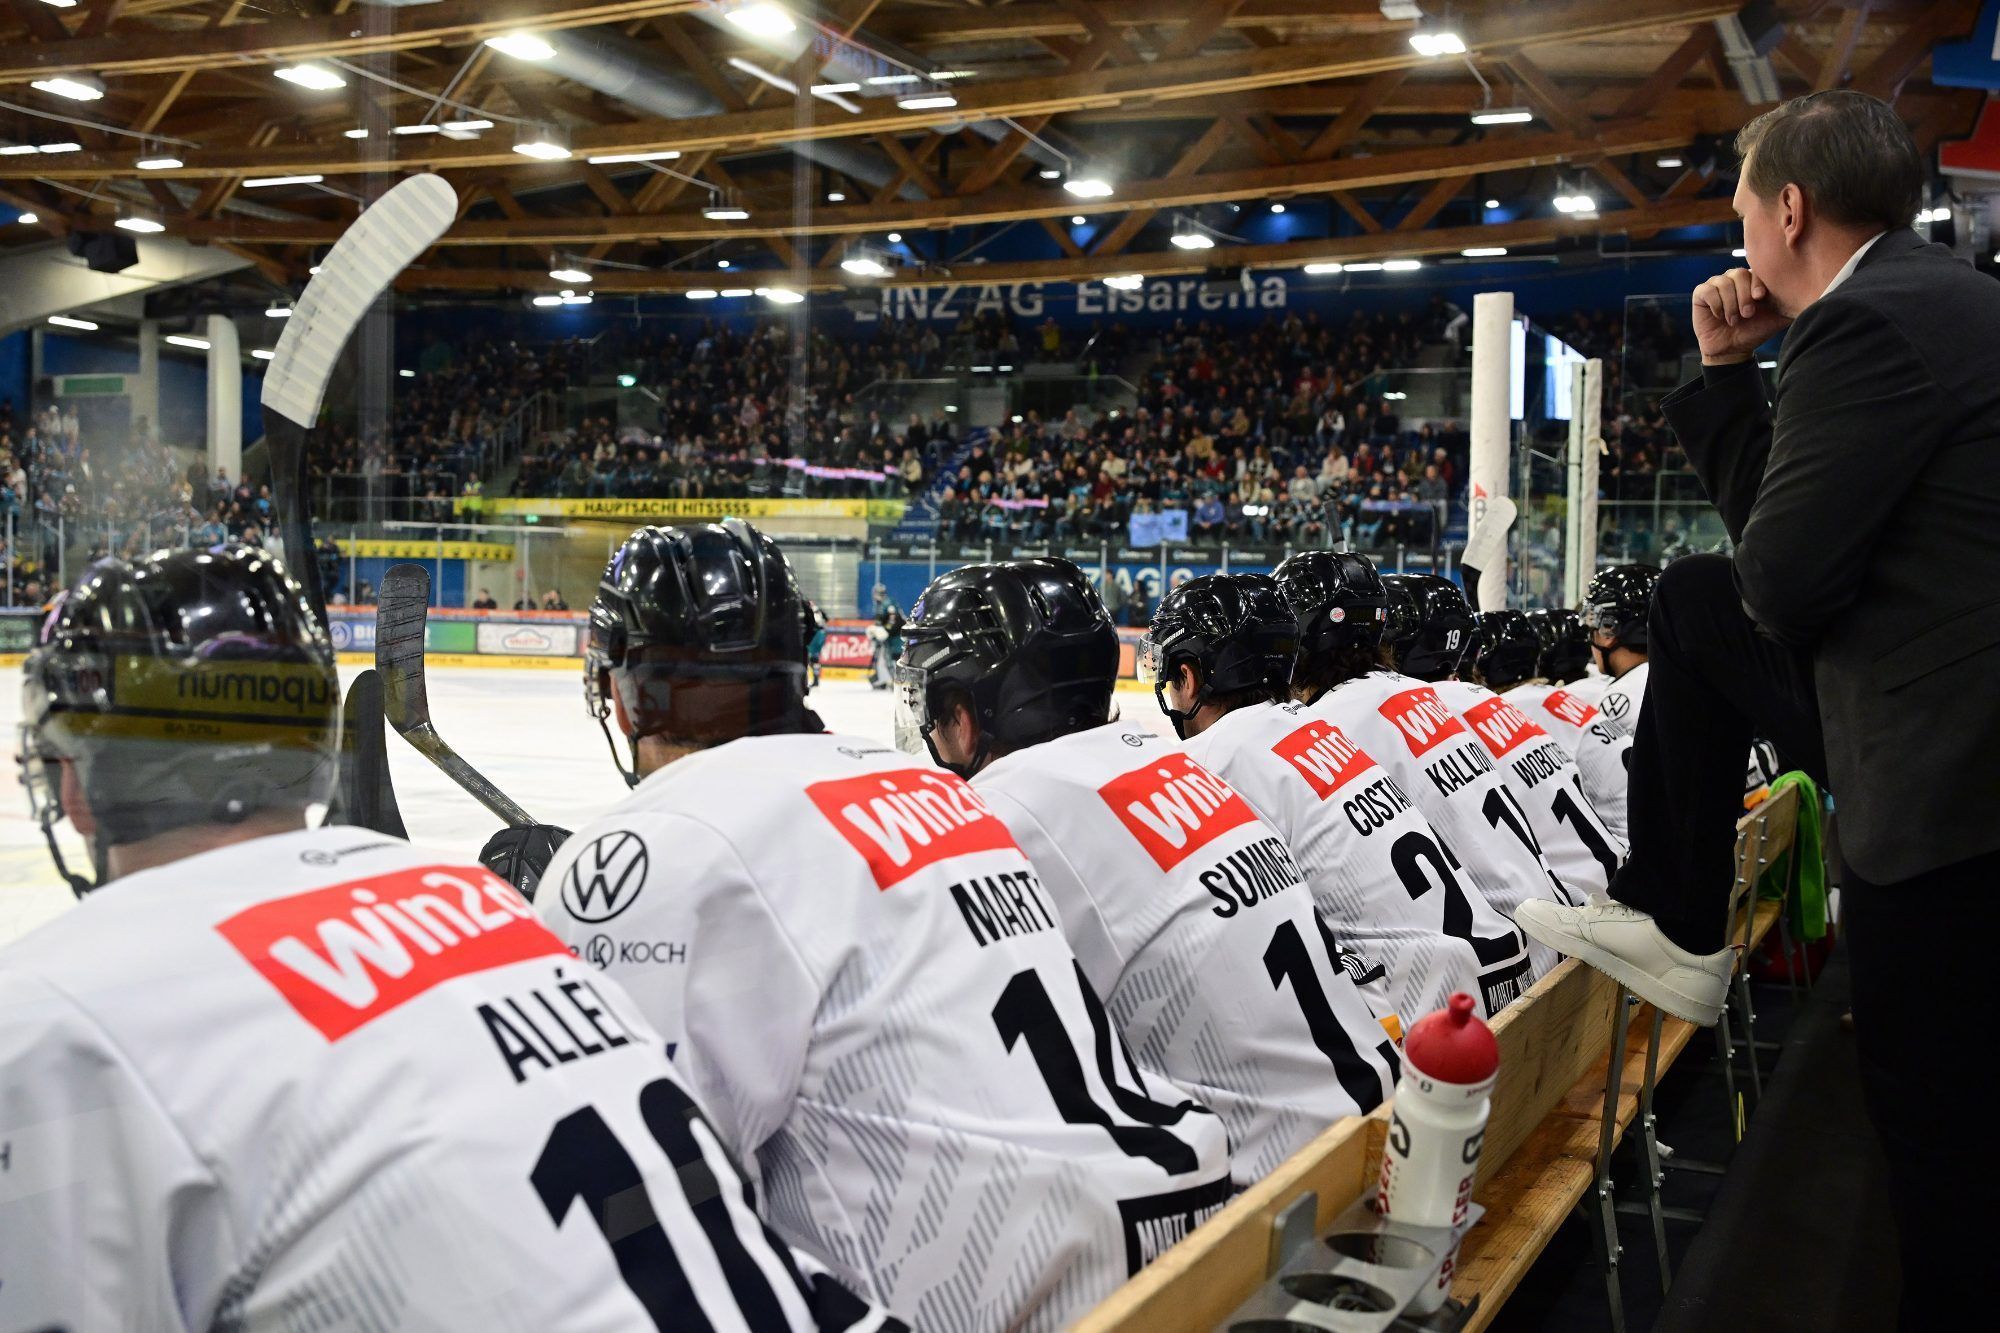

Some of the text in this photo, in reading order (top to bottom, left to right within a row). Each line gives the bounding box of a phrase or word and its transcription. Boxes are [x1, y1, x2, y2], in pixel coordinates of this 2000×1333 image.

[855, 284, 960, 320] INZ
[976, 283, 1044, 317] AG
[1445, 629, 1460, 650] 19
[948, 870, 1055, 948] MART
[620, 941, 687, 964] KOCH
[476, 967, 642, 1084] ALLÉ
